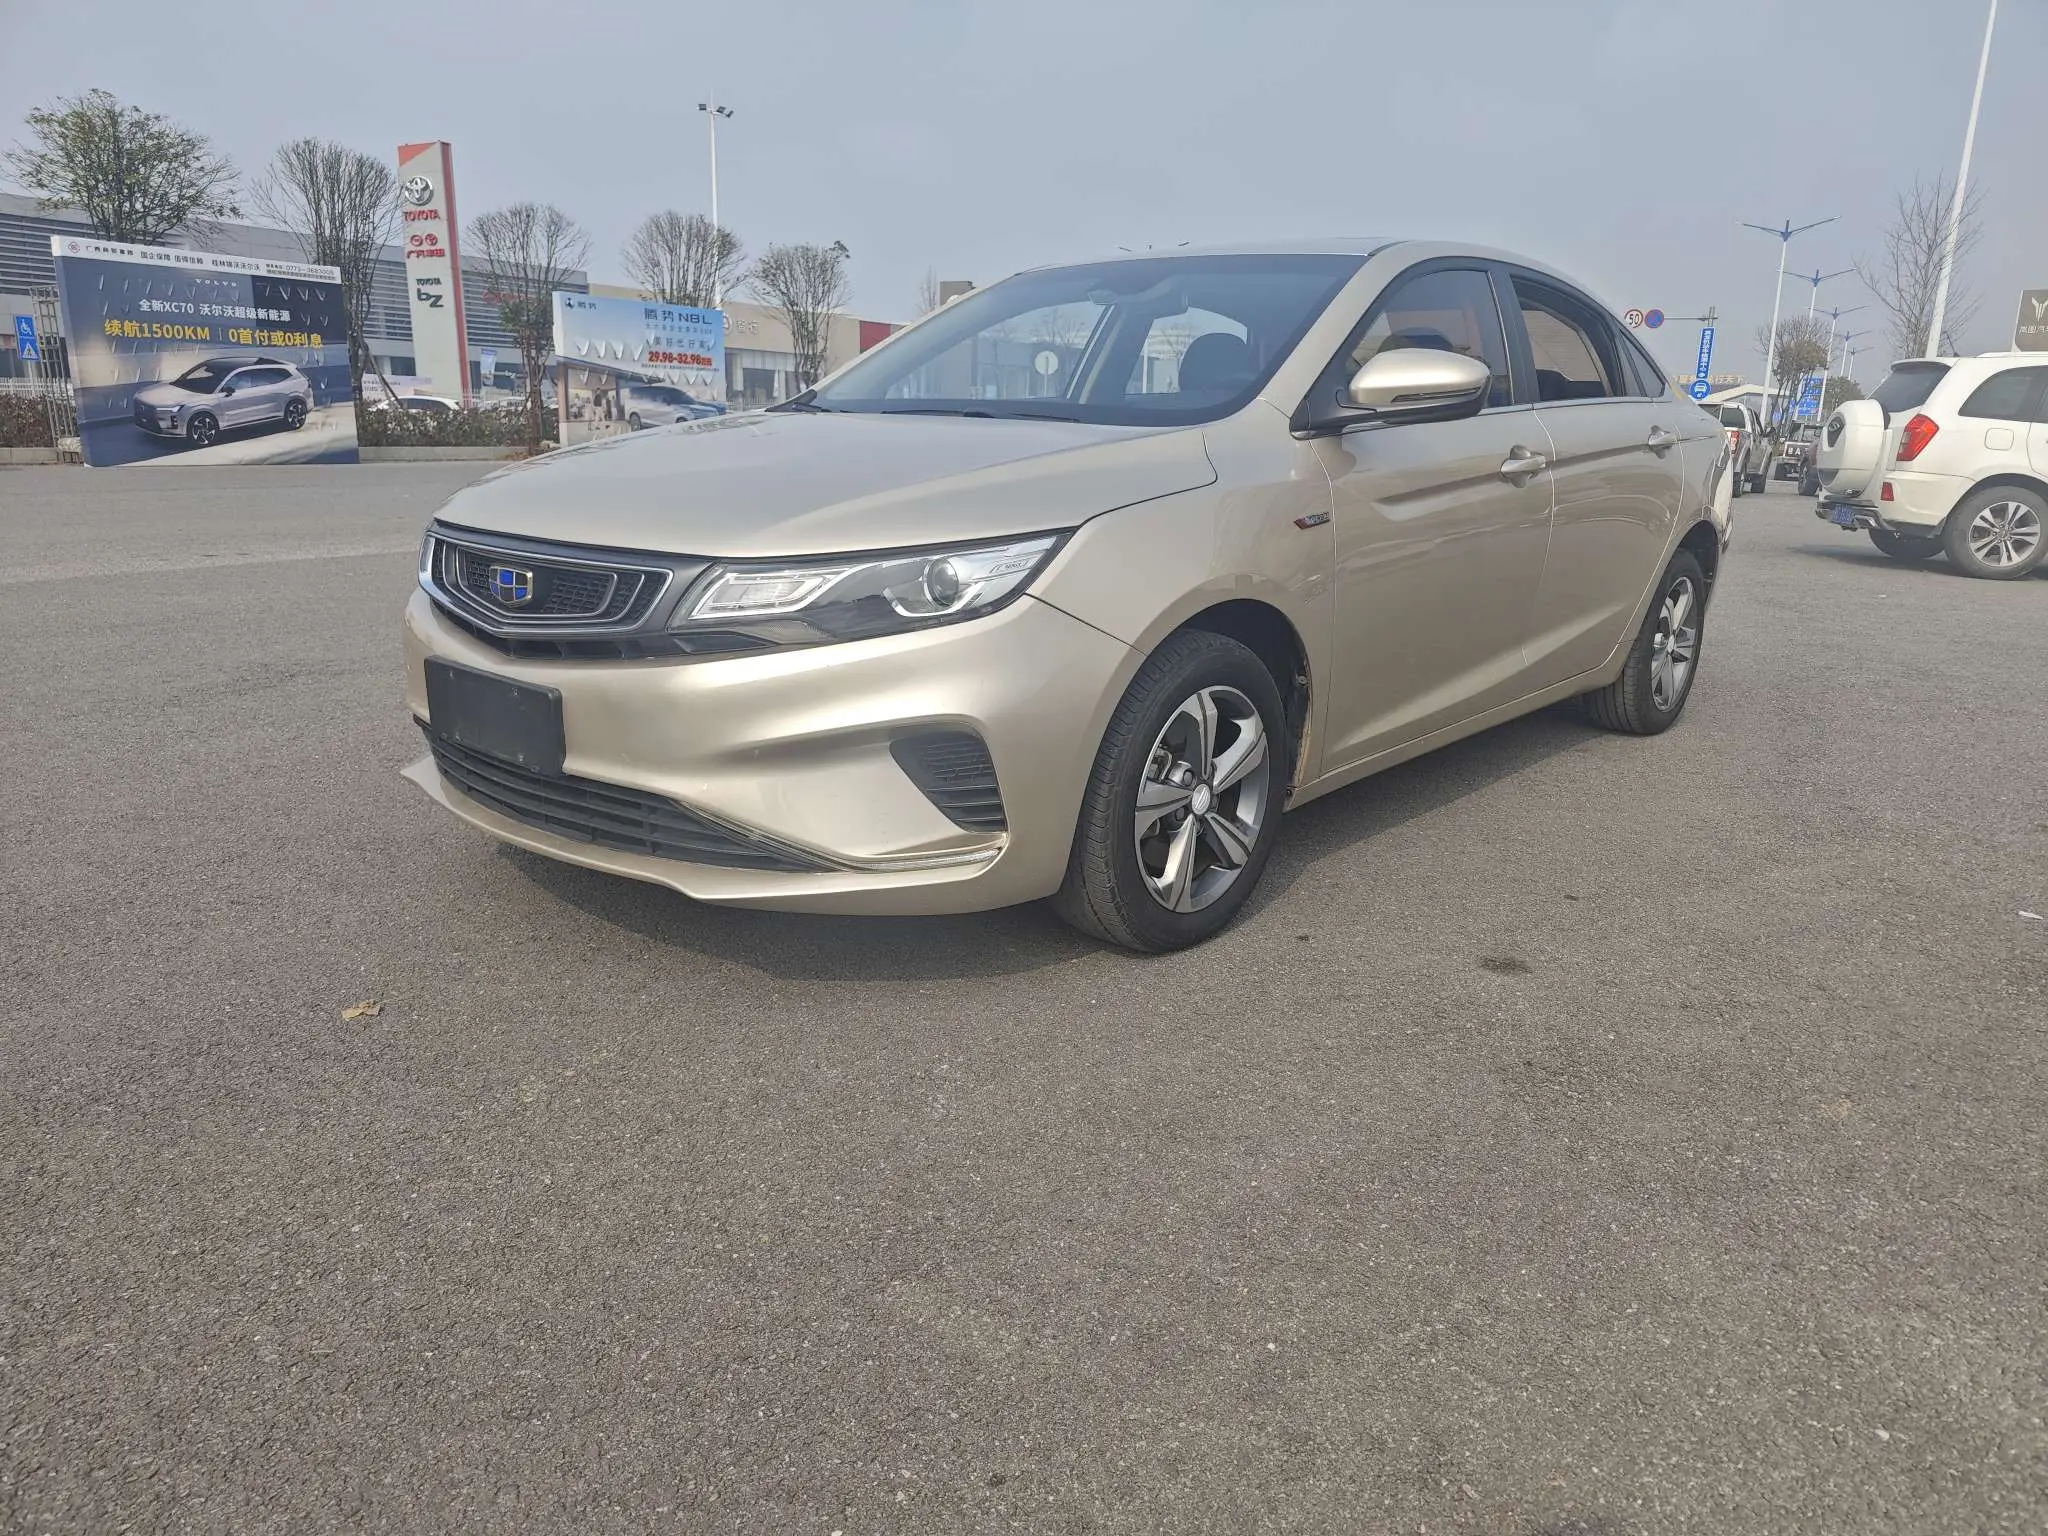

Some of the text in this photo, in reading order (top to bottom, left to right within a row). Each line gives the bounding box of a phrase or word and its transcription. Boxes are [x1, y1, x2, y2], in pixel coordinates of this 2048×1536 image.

[403, 208, 441, 222] TOYOTA
[194, 278, 238, 288] VOLVO
[416, 278, 442, 286] TOYOTA
[138, 298, 292, 322] 全新XC70 沃尔沃超级新能源
[1629, 313, 1640, 326] 50
[104, 319, 324, 349] 续航1500KM 0首付或0利息
